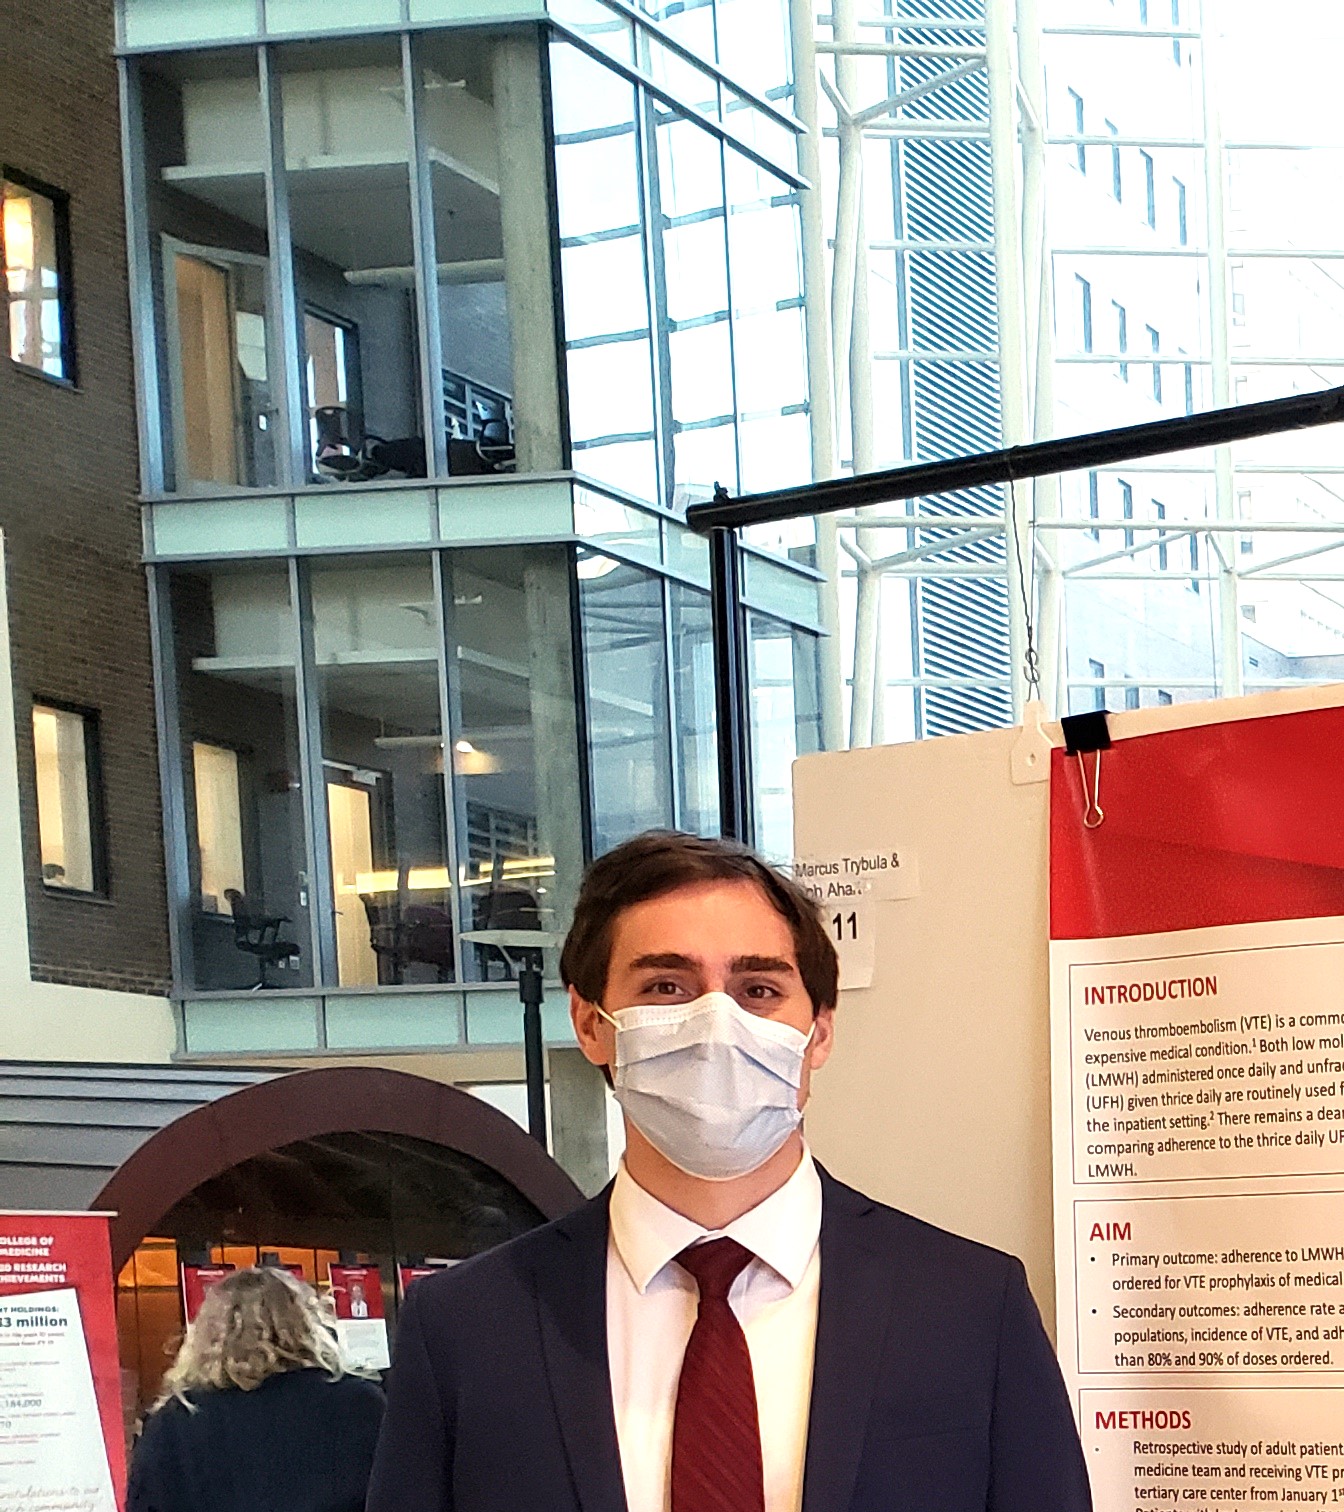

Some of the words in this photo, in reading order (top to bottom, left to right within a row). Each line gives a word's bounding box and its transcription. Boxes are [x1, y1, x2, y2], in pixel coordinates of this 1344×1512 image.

[842, 855, 887, 876] Trybula
[890, 853, 900, 868] &
[832, 911, 857, 941] 11
[1085, 976, 1217, 1005] INTRODUCTION
[1084, 1029, 1131, 1041] Venous
[1134, 1019, 1237, 1039] thromboembolism
[1240, 1014, 1271, 1034] (VTE)
[1275, 1014, 1285, 1028] is
[1289, 1017, 1295, 1027] a
[0, 1236, 38, 1246] OLLEGE
[1090, 1222, 1131, 1241] AIM
[14, 1263, 67, 1272] RESEARCH
[17, 1315, 68, 1328] million
[1096, 1410, 1191, 1429] METHODS
